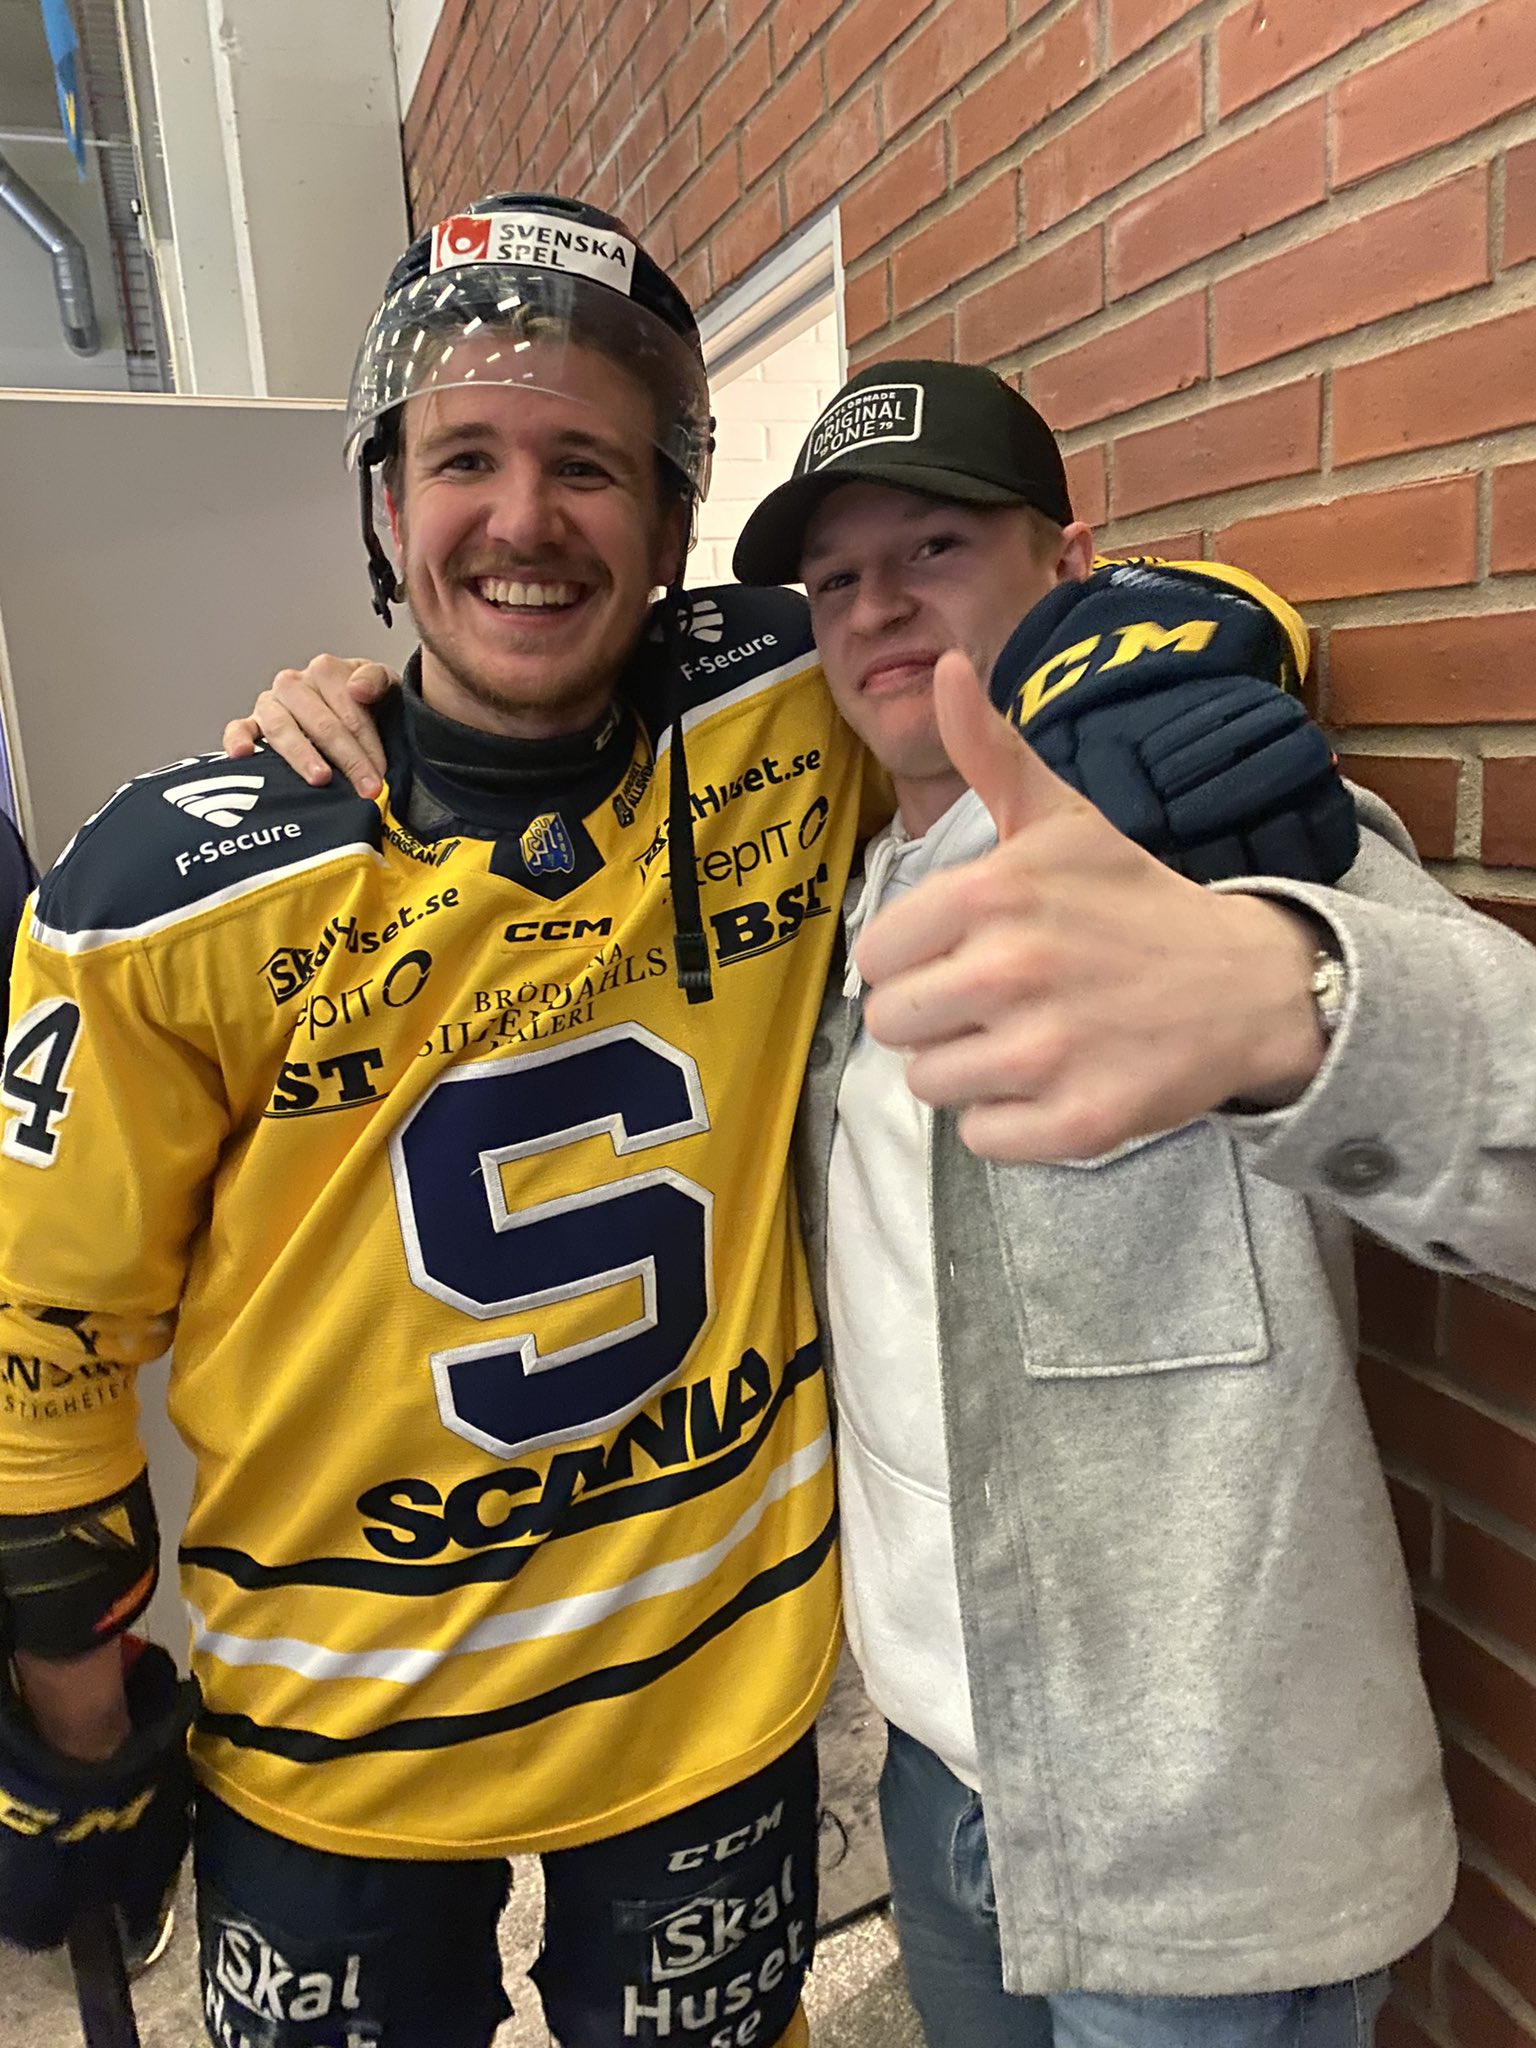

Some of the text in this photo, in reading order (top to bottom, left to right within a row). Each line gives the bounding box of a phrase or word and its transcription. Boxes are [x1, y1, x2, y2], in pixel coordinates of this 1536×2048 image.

[496, 243, 566, 268] SPEL
[499, 223, 627, 268] SVENSKA
[813, 400, 906, 455] ORIGINAL
[830, 420, 876, 451] ONE
[878, 421, 894, 431] 79
[680, 631, 779, 682] F-Secure
[1005, 620, 1219, 726] CM
[174, 820, 302, 877] F-Secure
[503, 917, 613, 943] CCM
[2, 997, 82, 1170] 4
[273, 1048, 384, 1111] ST
[388, 1020, 717, 1460] S
[356, 1347, 773, 1560] SCANIA
[667, 1800, 784, 1873] CCM
[663, 1854, 796, 1969] Skal
[222, 1928, 361, 2022] Skal
[623, 1919, 806, 2037] Huset
